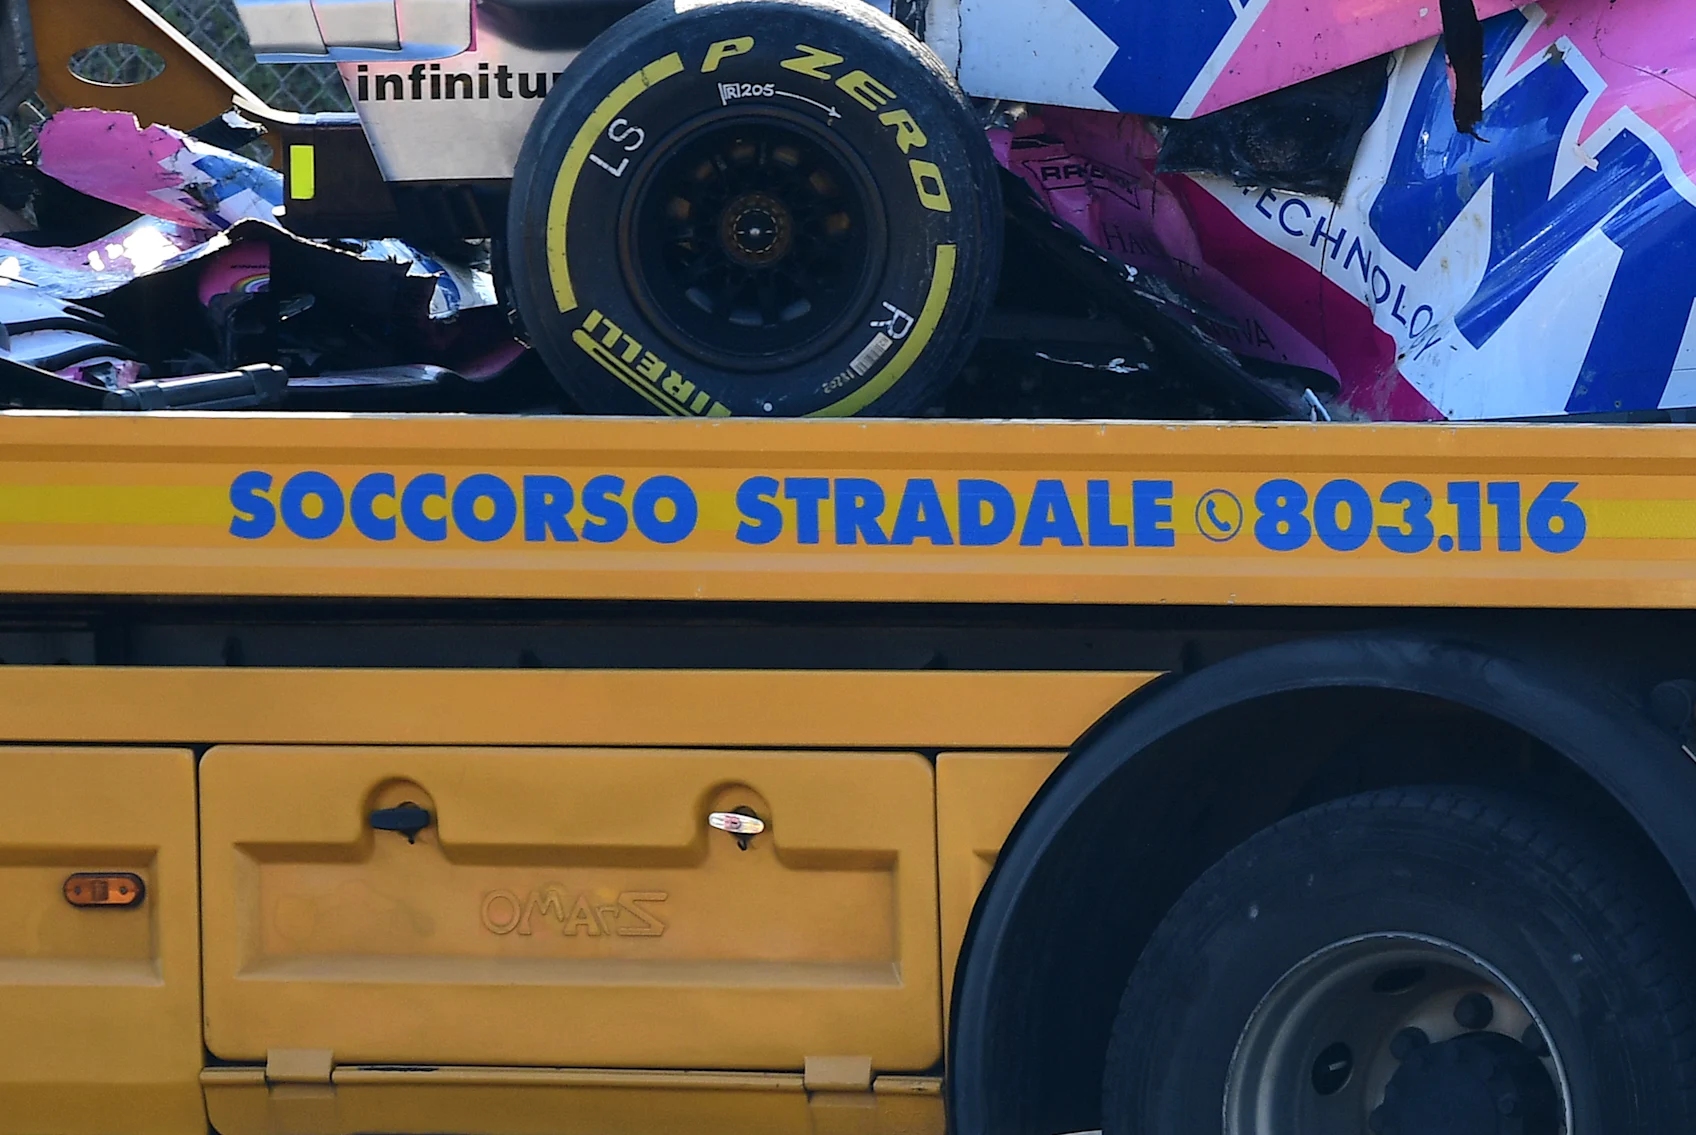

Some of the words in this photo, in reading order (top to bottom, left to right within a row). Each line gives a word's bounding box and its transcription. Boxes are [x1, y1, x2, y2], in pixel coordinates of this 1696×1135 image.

[589, 118, 646, 178] LS
[701, 36, 755, 73] P
[780, 44, 952, 213] ZERO
[869, 301, 915, 340] R
[228, 470, 699, 544] SOCCORSO
[735, 476, 1175, 546] STRADALE
[1253, 478, 1588, 554] 803.116
